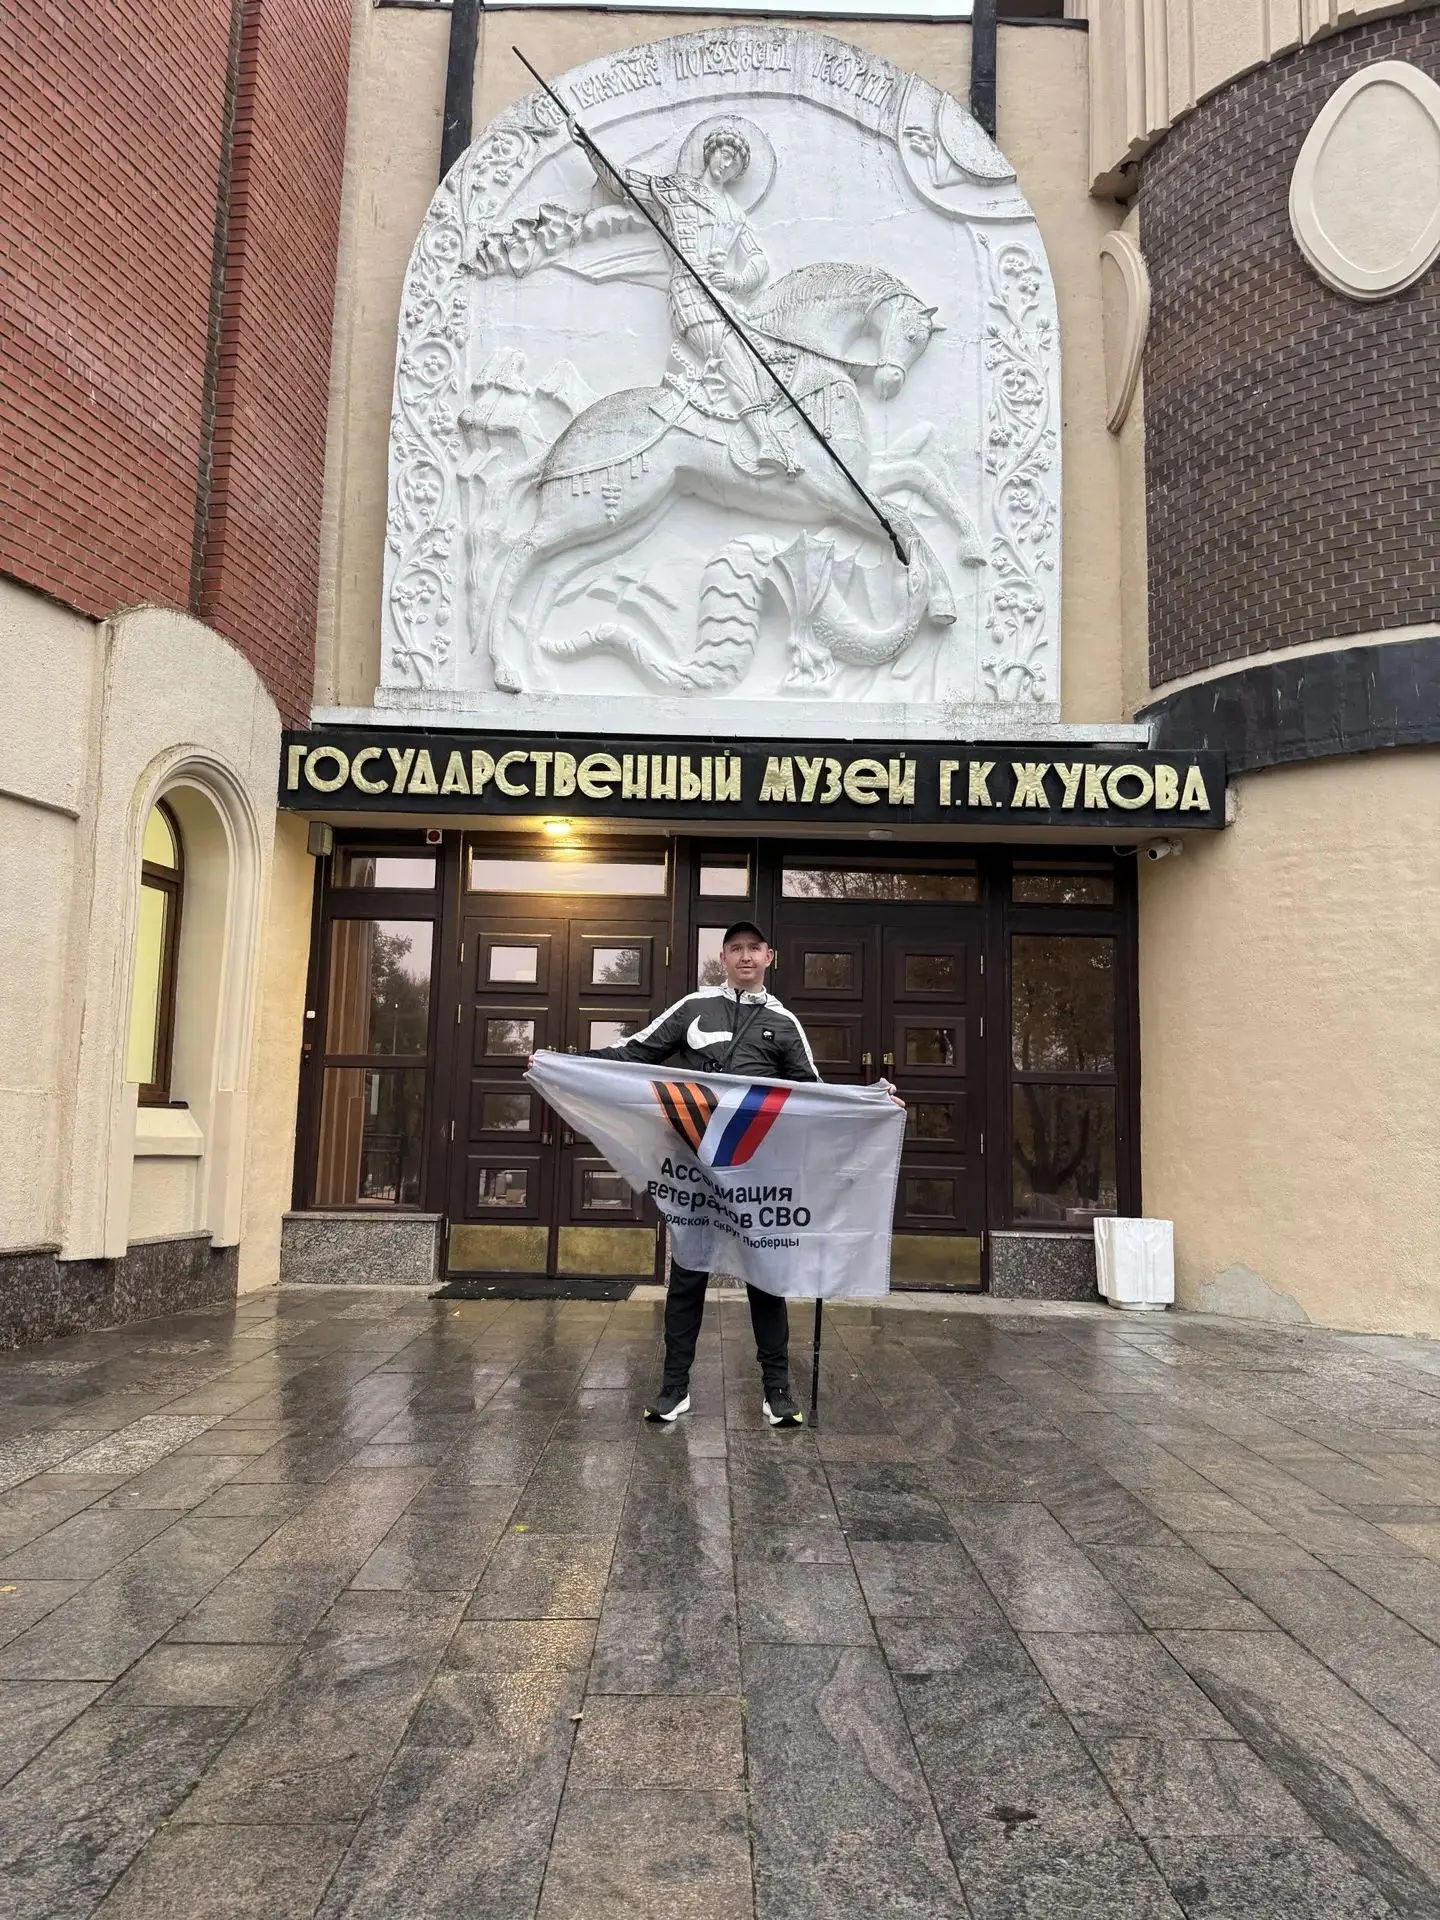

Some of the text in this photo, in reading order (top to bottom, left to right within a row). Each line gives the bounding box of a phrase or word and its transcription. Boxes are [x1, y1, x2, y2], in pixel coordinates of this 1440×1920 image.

[1010, 762, 1211, 812] ЖУКОВА
[647, 1180, 811, 1229] ветеранов СВО
